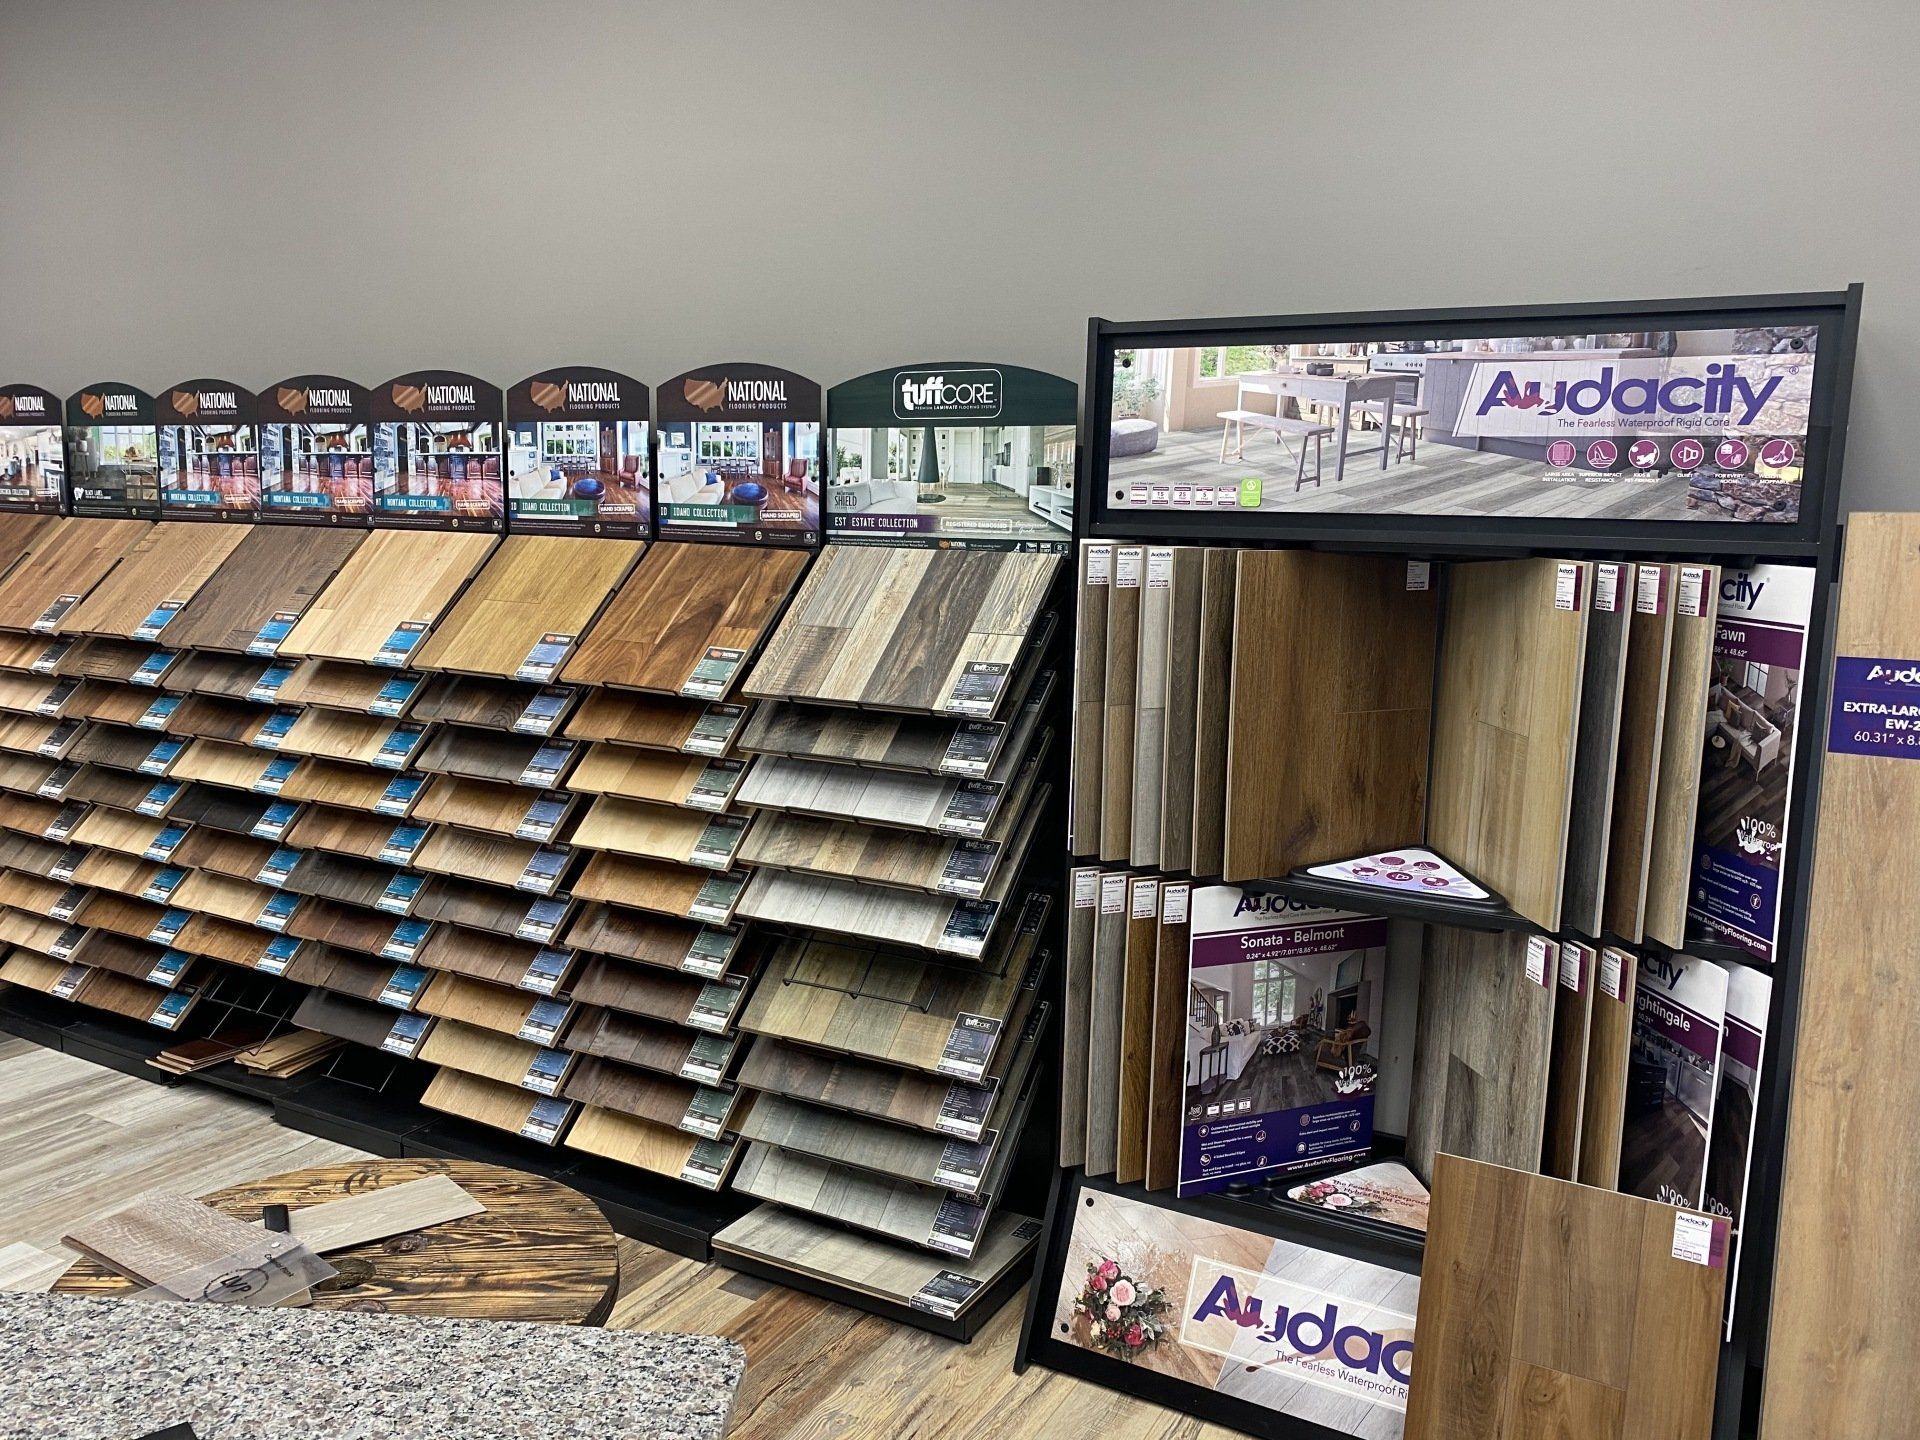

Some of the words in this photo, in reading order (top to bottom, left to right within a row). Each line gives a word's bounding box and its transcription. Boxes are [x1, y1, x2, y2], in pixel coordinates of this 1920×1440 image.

[309, 389, 353, 407] NATIONAL
[427, 385, 476, 404] NATIONAL
[568, 382, 621, 402] NATIONAL
[728, 380, 787, 402] NATIONAL
[1476, 362, 1784, 426] Audacity
[15, 396, 46, 411] NATIONAL
[104, 395, 138, 411] NATIONAL
[199, 392, 238, 409] NATIONAL
[758, 402, 787, 410] PRODUCTS
[1557, 418, 1575, 428] The
[1577, 418, 1616, 428] Fearless
[1618, 417, 1675, 429] Waterproof
[1676, 417, 1701, 428] Rigid
[1704, 417, 1730, 427] Core
[187, 494, 211, 503] COLLECTION
[273, 496, 291, 504] MONTANA
[293, 496, 319, 505] COLLECTION
[387, 498, 407, 507] MONTANA
[408, 499, 437, 508] COLLECTION
[834, 496, 857, 506] SHIELD
[511, 502, 517, 511] ID
[522, 502, 538, 511] IDAHO
[540, 503, 571, 513] COLLECTION
[660, 507, 668, 516] ID
[673, 507, 691, 517] IDAHO
[693, 508, 728, 519] COLLECTION
[834, 517, 847, 527] EST
[852, 517, 875, 528] ESTATE
[878, 518, 918, 529] COLLECTION
[1089, 548, 1112, 556] Audacity
[1720, 572, 1765, 611] city
[1715, 624, 1746, 643] Fawn
[1843, 701, 1920, 717] EXTRA-LAR
[1854, 730, 1895, 743] 60.31"
[1896, 736, 1905, 745] x
[1906, 734, 1920, 746] 8.
[1745, 815, 1777, 839] 100%
[1240, 934, 1283, 949] Sonata
[1294, 927, 1345, 943] Belmont
[1687, 911, 1767, 952] www.AudacityFlooring.com
[1636, 991, 1691, 1032] ightingale
[1343, 1063, 1372, 1077] 100%
[1333, 1179, 1347, 1187] The
[1348, 1183, 1381, 1195] Fearless
[1382, 1190, 1430, 1206] Waterproof
[1343, 1187, 1373, 1200] Hybrid
[1373, 1194, 1394, 1205] Rigid
[1394, 1200, 1416, 1208] Core
[1677, 1214, 1710, 1229] Audacity
[220, 1275, 252, 1293] LVP
[1192, 1274, 1414, 1386] Audac
[1275, 1349, 1294, 1366] The
[1295, 1355, 1336, 1378] Fearless
[1337, 1367, 1397, 1397] Waterproof
